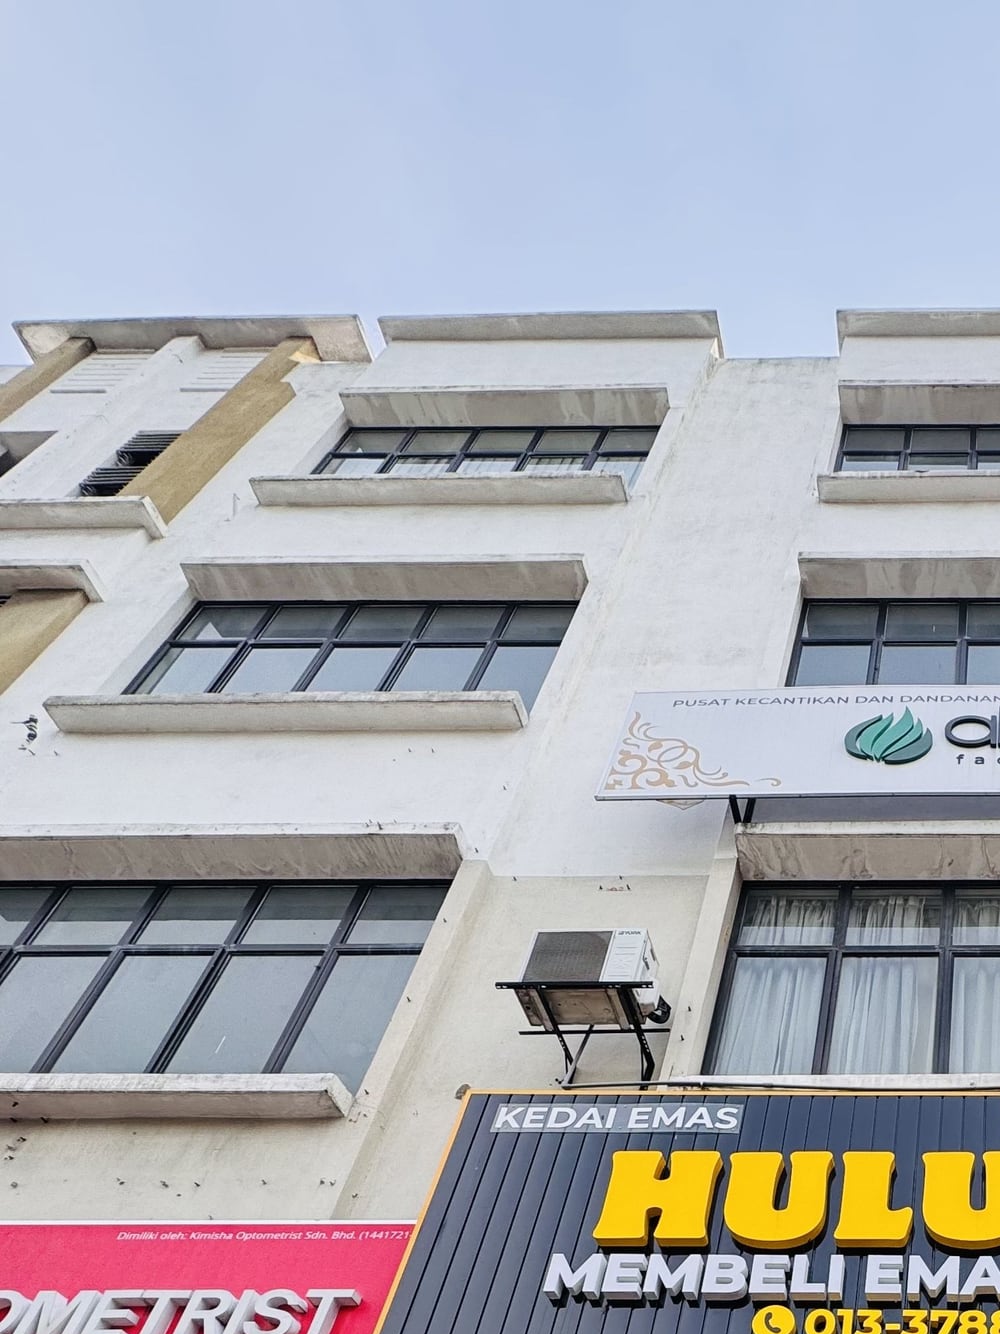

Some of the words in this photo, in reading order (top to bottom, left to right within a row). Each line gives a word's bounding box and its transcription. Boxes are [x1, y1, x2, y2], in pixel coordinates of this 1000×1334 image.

[673, 698, 731, 707] PUSAT
[735, 696, 849, 706] KECANTIKAN
[855, 695, 894, 705] DAN
[494, 1105, 617, 1129] KEDAI
[626, 1106, 740, 1129] EMAS
[117, 1231, 159, 1240] Dimiliki
[160, 1231, 187, 1240] oleh:
[189, 1231, 234, 1240] Kimisha
[235, 1231, 303, 1241] Optometrist
[304, 1231, 329, 1240] Sdn.
[331, 1231, 356, 1240] Bhd.
[543, 1252, 846, 1301] MEMBELI
